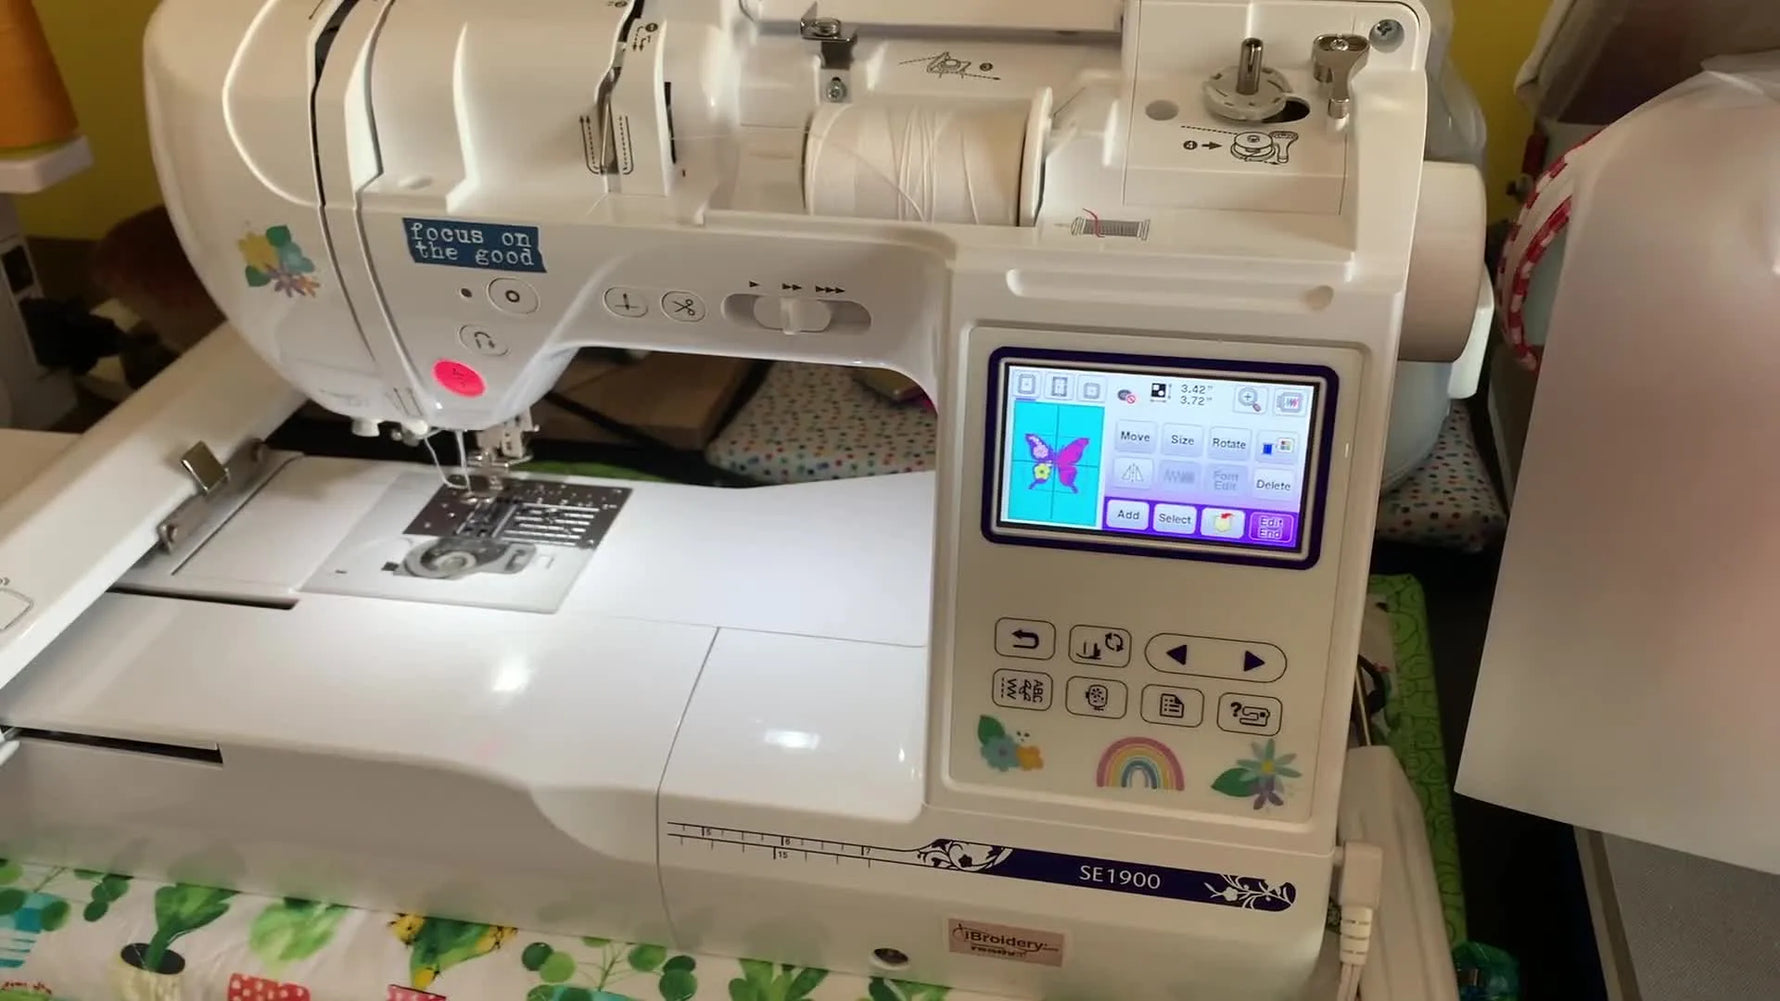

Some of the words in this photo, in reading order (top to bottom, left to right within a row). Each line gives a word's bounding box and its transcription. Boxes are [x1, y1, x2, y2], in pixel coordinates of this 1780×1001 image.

[411, 222, 484, 244] focus
[502, 231, 532, 247] on
[415, 241, 458, 260] the
[475, 248, 534, 265] good
[1120, 430, 1150, 442] Move
[1171, 434, 1195, 446] Size
[1212, 438, 1247, 450] Rotate
[1256, 479, 1291, 491] Delete
[1117, 509, 1140, 520] Add
[1158, 513, 1191, 525] Select
[1260, 516, 1283, 527] Edit
[1259, 527, 1282, 538] End
[1032, 679, 1044, 702] ABC
[1079, 864, 1160, 889] SE1900
[965, 929, 1044, 952] iBroidery
